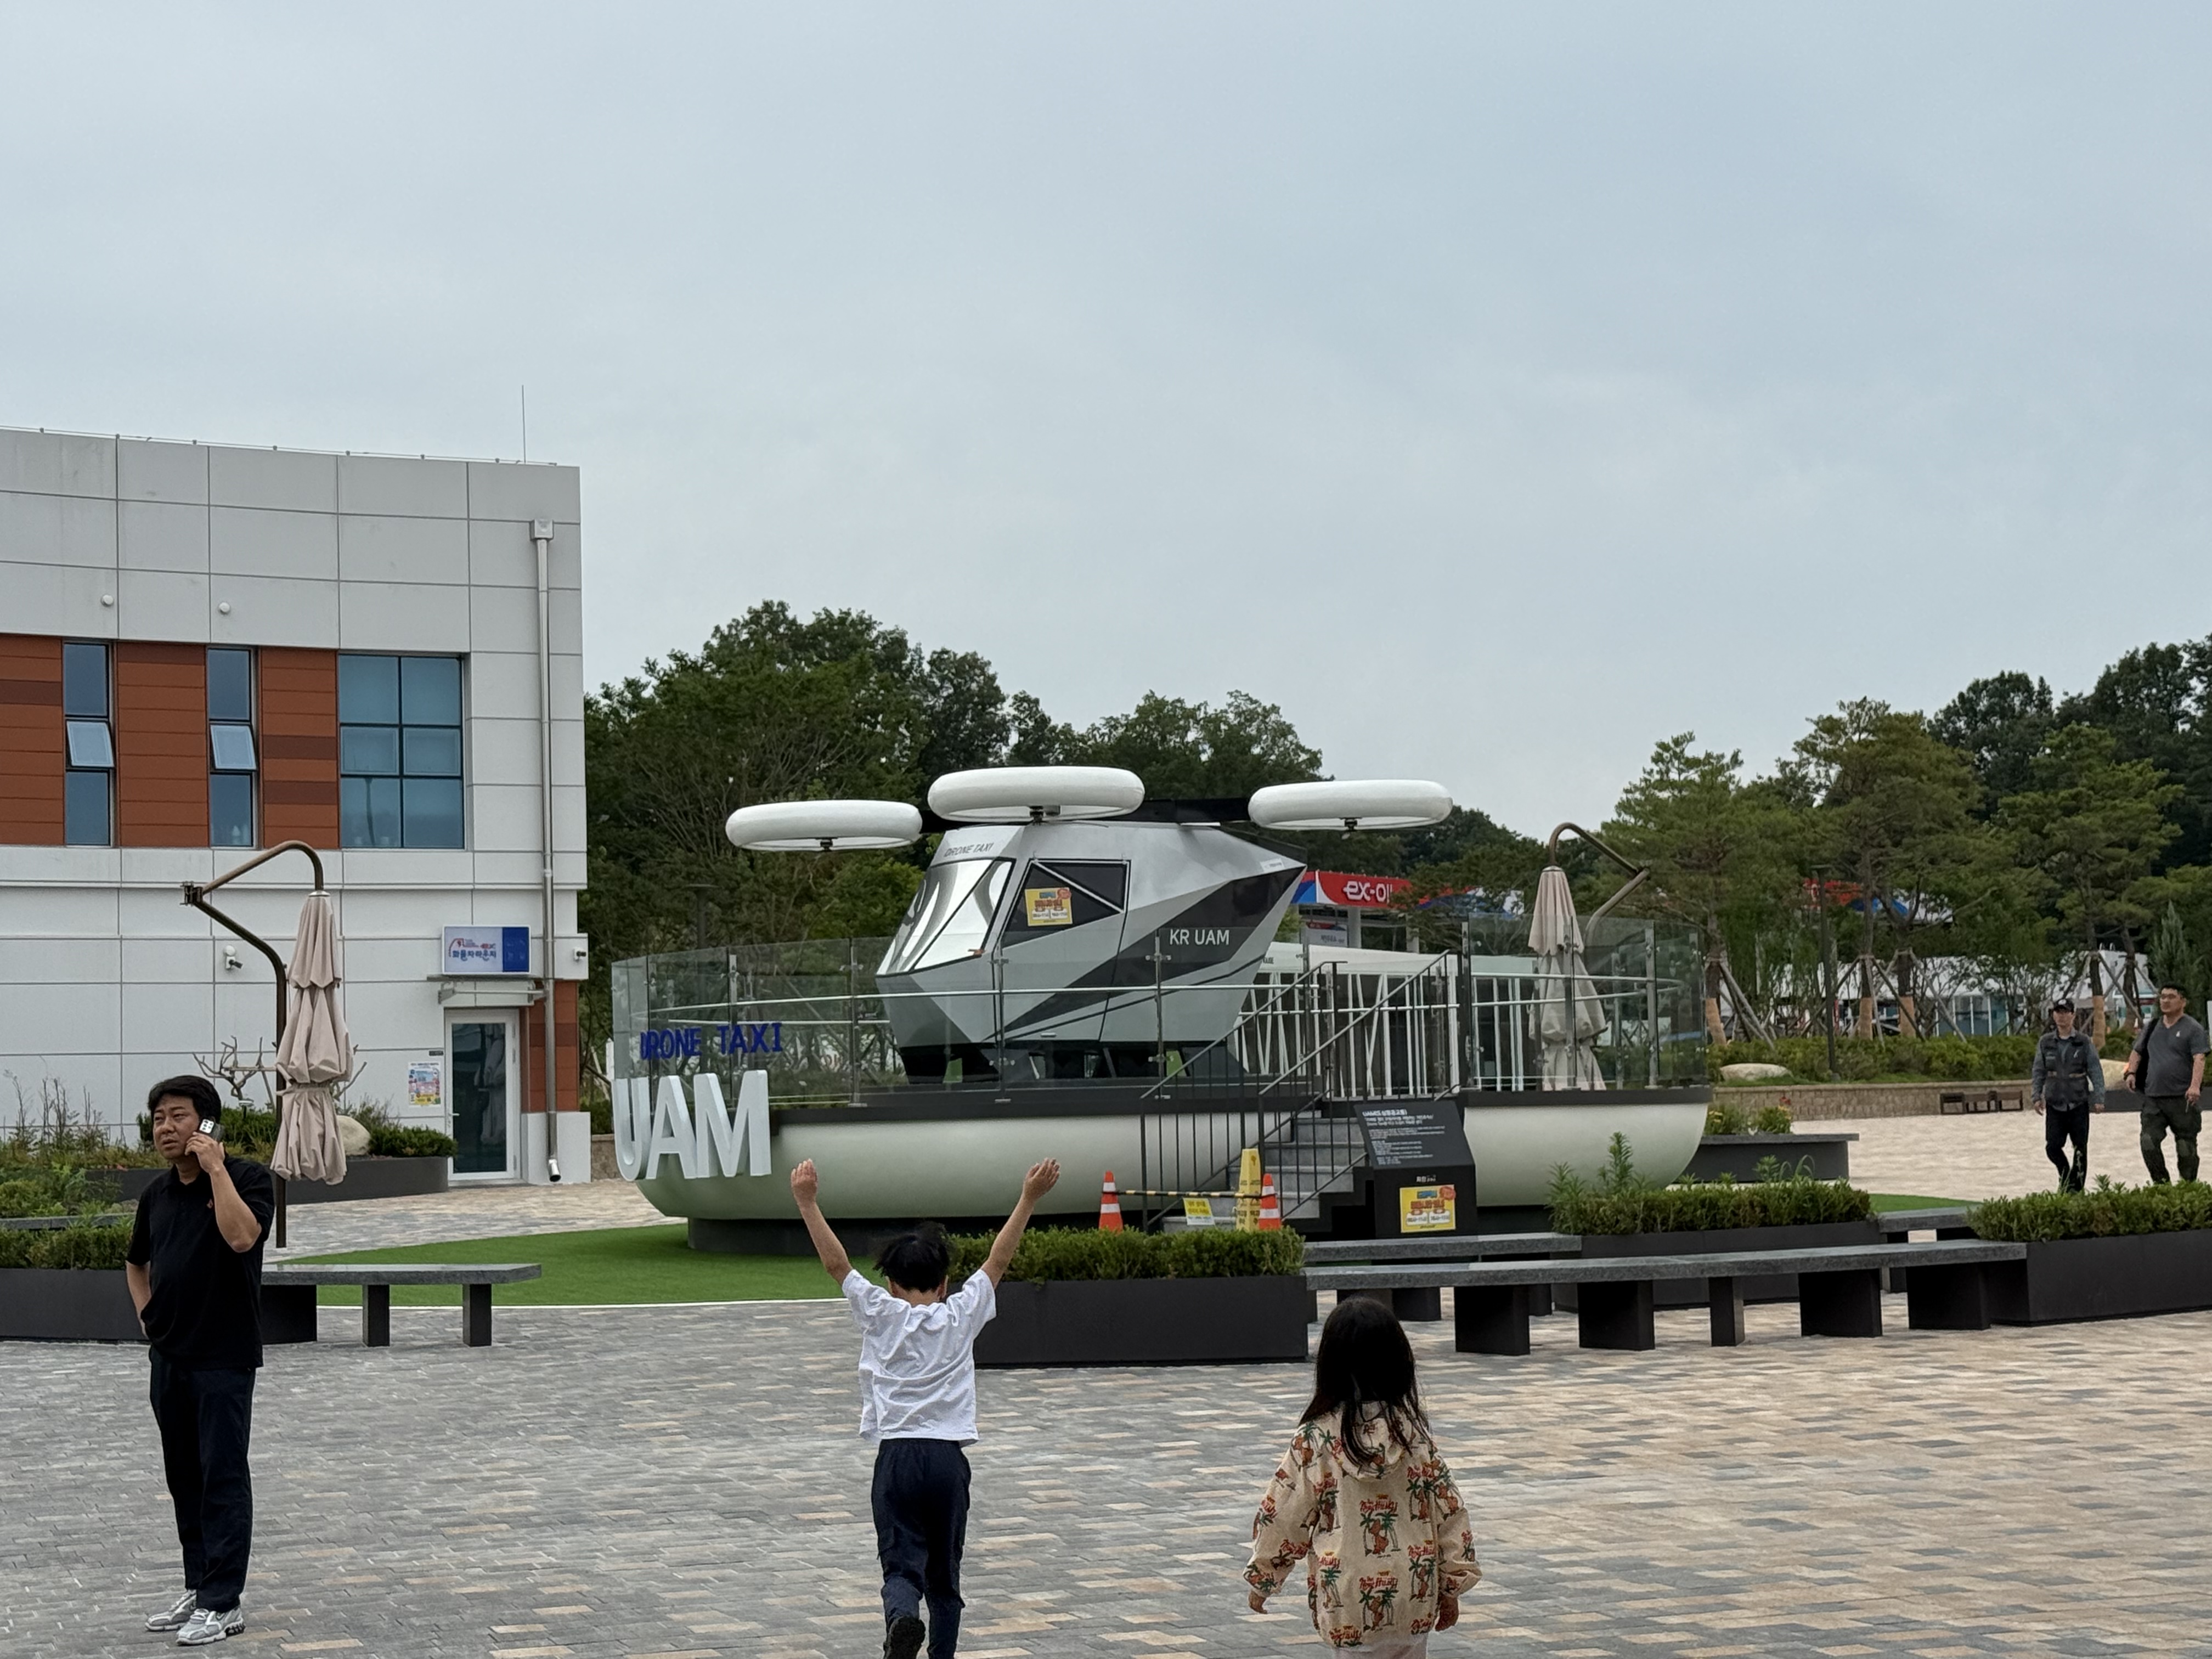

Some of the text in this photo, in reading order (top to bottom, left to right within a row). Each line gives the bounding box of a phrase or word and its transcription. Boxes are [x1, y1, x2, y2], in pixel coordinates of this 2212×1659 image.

[944, 842, 995, 857] DRONE TAXI
[1170, 929, 1229, 945] KR UAM
[716, 1022, 783, 1055] TAXI
[611, 1069, 772, 1182] UAM
